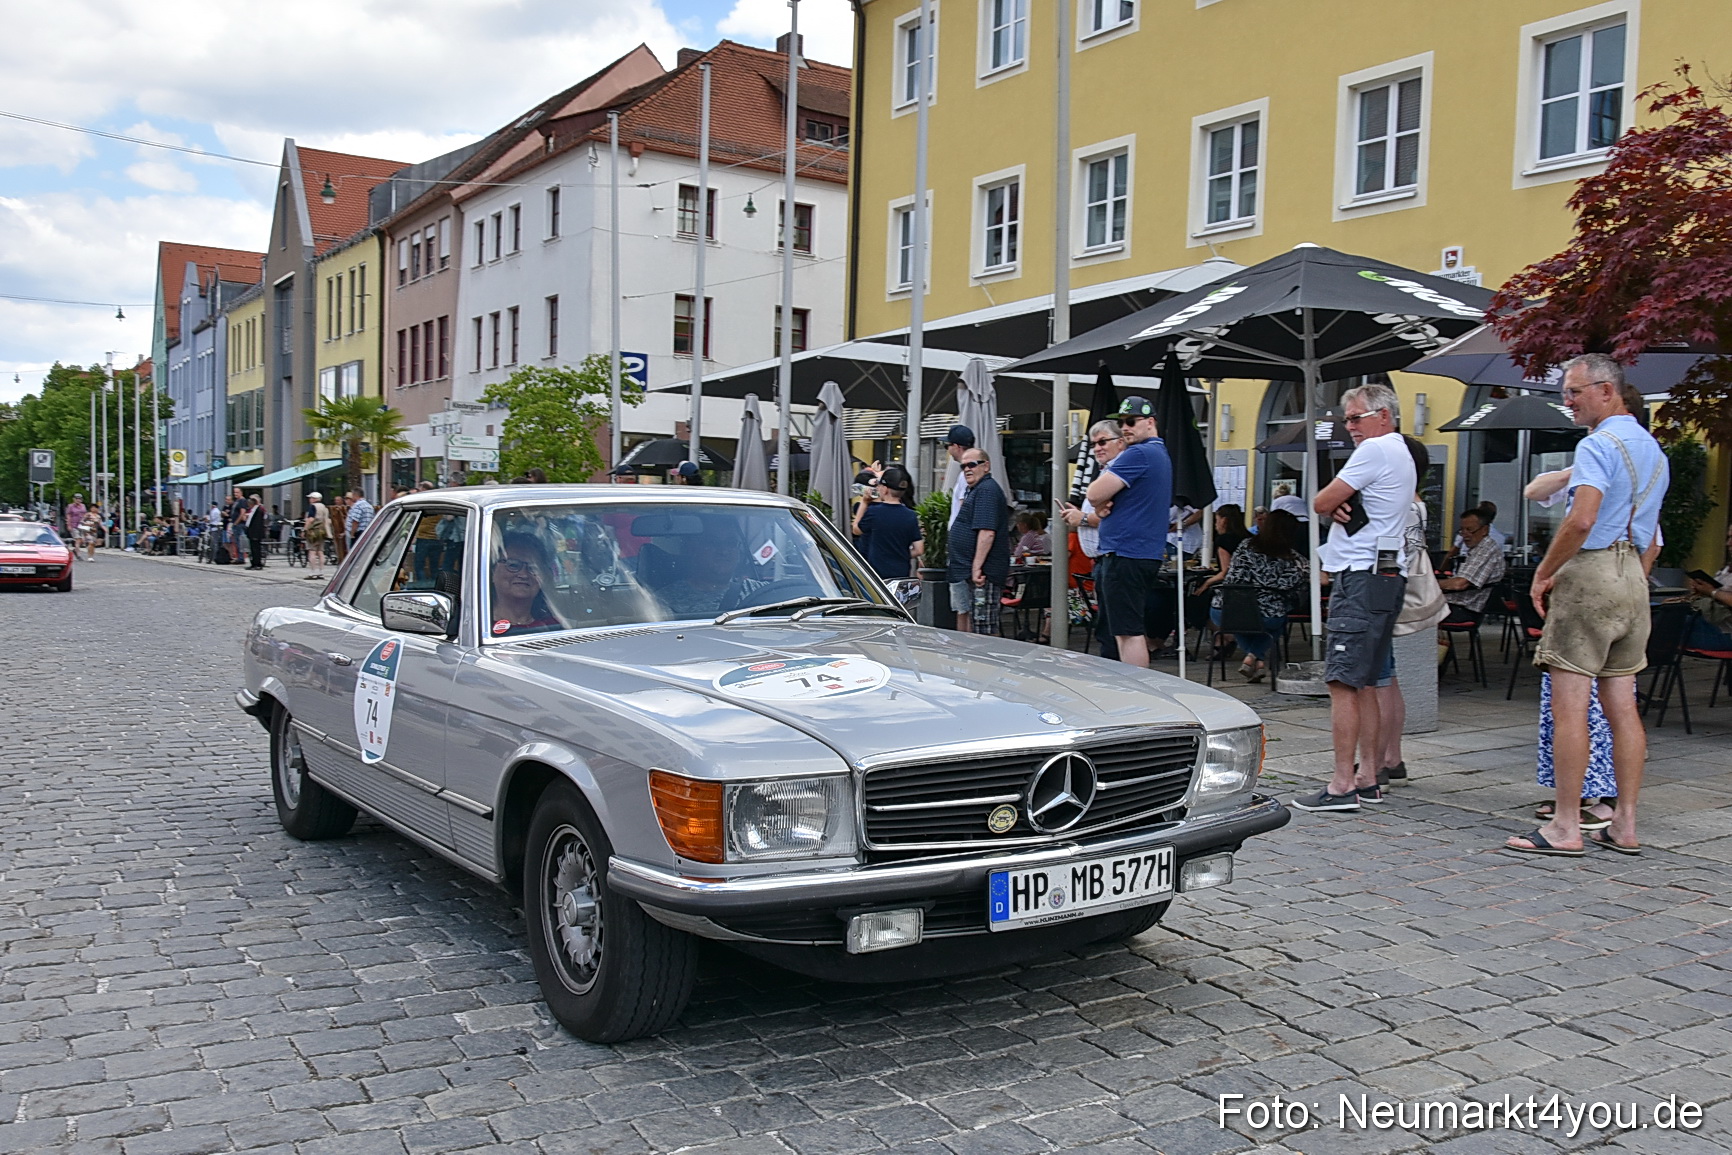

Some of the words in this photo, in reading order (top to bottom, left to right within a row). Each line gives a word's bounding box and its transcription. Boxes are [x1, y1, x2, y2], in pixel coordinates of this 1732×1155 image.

[1128, 285, 1249, 339] now
[1458, 404, 1498, 426] now
[784, 673, 842, 688] 74
[366, 698, 378, 728] 74
[1012, 872, 1049, 912] HP
[1071, 863, 1104, 903] MB
[1112, 851, 1171, 896] 577H
[995, 902, 1004, 914] D
